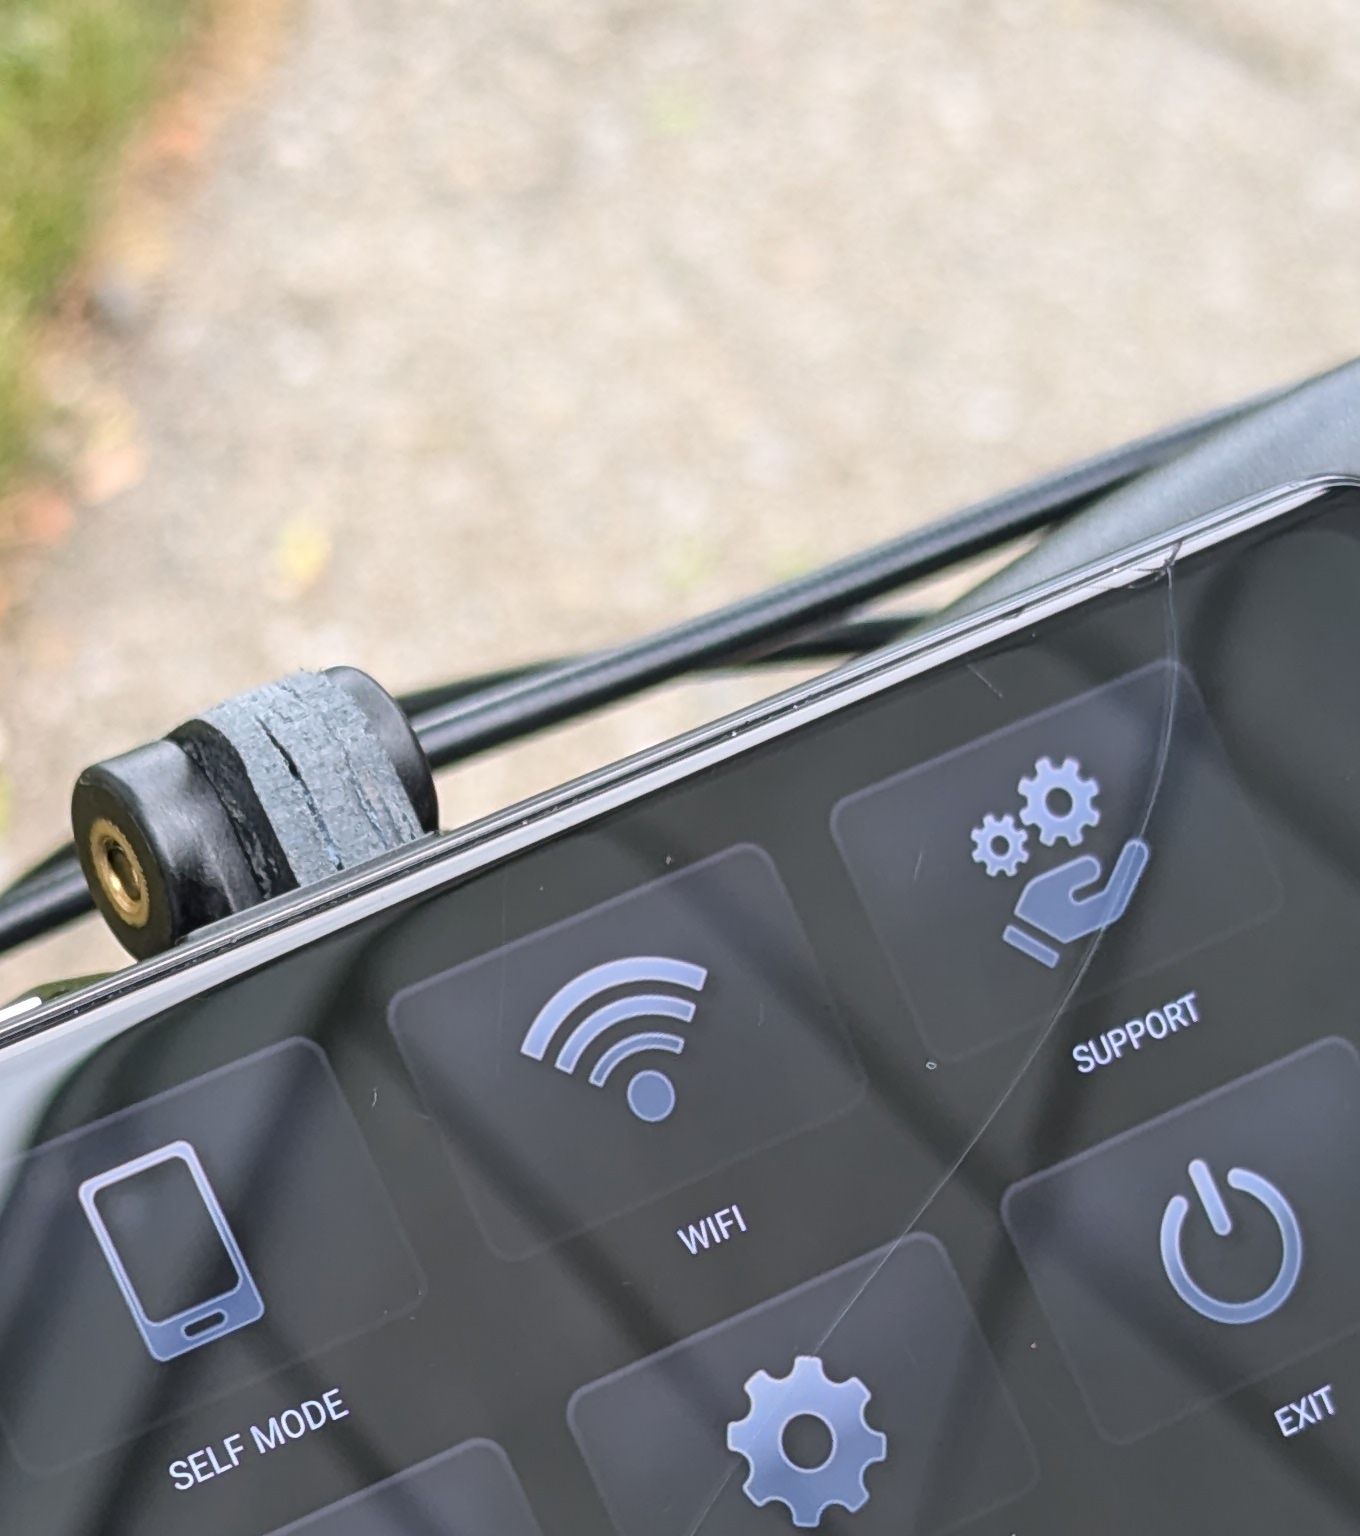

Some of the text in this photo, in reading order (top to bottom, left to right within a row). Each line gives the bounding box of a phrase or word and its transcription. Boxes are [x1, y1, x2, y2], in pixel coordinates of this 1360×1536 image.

[1071, 992, 1200, 1073] SUPPORT
[676, 1204, 748, 1255] WIFI
[167, 1388, 350, 1491] SELF MODE
[1272, 1384, 1336, 1437] EXIT
